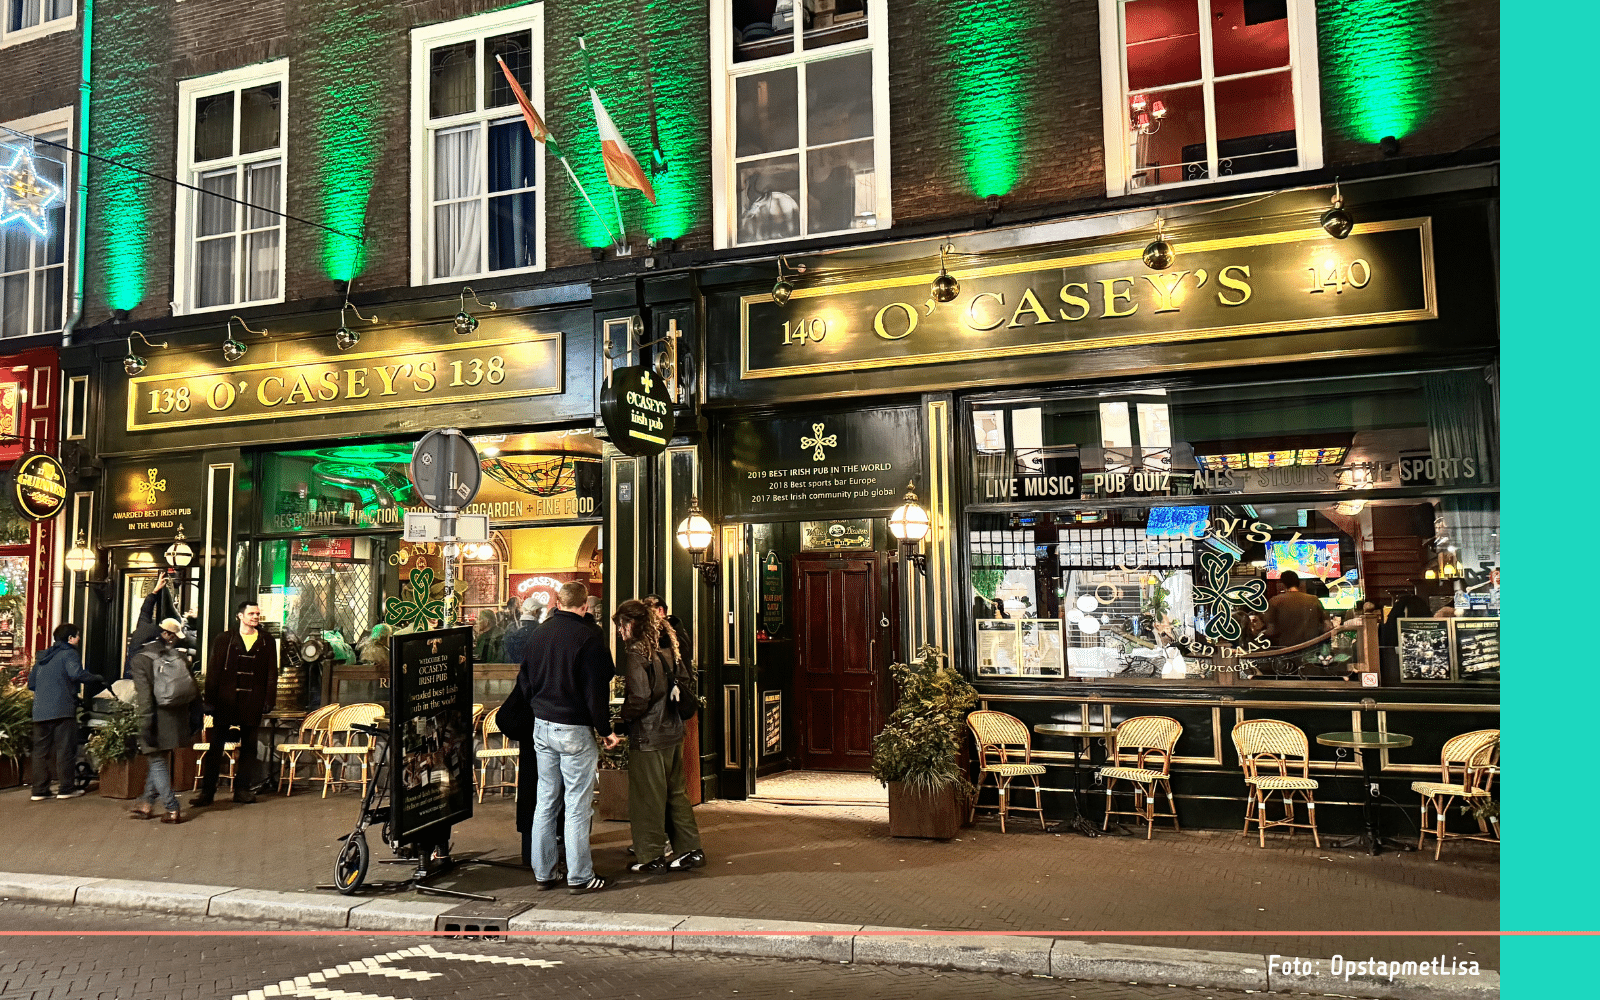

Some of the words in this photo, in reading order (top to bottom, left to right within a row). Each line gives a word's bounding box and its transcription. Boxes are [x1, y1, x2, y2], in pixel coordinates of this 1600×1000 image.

[781, 317, 827, 345] 140
[1308, 258, 1371, 294] 140
[147, 386, 191, 414] 138
[449, 355, 506, 387] 138
[626, 390, 667, 416] O'CASEY'S
[630, 409, 648, 426] irish
[648, 417, 664, 431] pub
[747, 470, 767, 479] 2019
[768, 469, 788, 478] BEST
[789, 468, 811, 477] IRISH
[813, 466, 829, 475] PUB
[830, 465, 840, 474] IN
[841, 464, 859, 473] THE
[860, 462, 892, 472] WORLD
[985, 477, 1019, 498] LIVE
[1024, 475, 1075, 497] MUSIC
[1093, 473, 1126, 494] PUB
[1132, 471, 1171, 492] QUIZ
[1192, 468, 1235, 490] ALES
[1257, 465, 1331, 488] STOUTS
[1351, 462, 1393, 483] LIVE
[1400, 456, 1476, 481] SPORTS
[769, 481, 789, 490] 2018
[790, 480, 807, 488] Best
[808, 479, 832, 489] sports
[834, 477, 847, 486] bar
[849, 476, 877, 487] Europe
[751, 494, 771, 503] 2017
[772, 493, 789, 502] Best
[790, 492, 807, 501] Irish
[808, 490, 852, 500] community
[853, 489, 869, 499] pub
[871, 487, 896, 498] global
[112, 511, 143, 520] AWARDED
[144, 509, 160, 518] BEST
[160, 508, 178, 517] IRISH
[178, 507, 192, 516] PUB
[274, 510, 338, 529] RESTAURANT
[349, 507, 399, 525] FUNCTION
[536, 498, 561, 516] FINE
[564, 496, 595, 515] FOOD
[136, 522, 150, 530] THE
[150, 520, 174, 529] WORLD
[36, 528, 48, 636] CANTINA
[418, 674, 435, 686] IRISH
[435, 672, 448, 683] PUB
[432, 687, 445, 697] best
[430, 699, 441, 709] the
